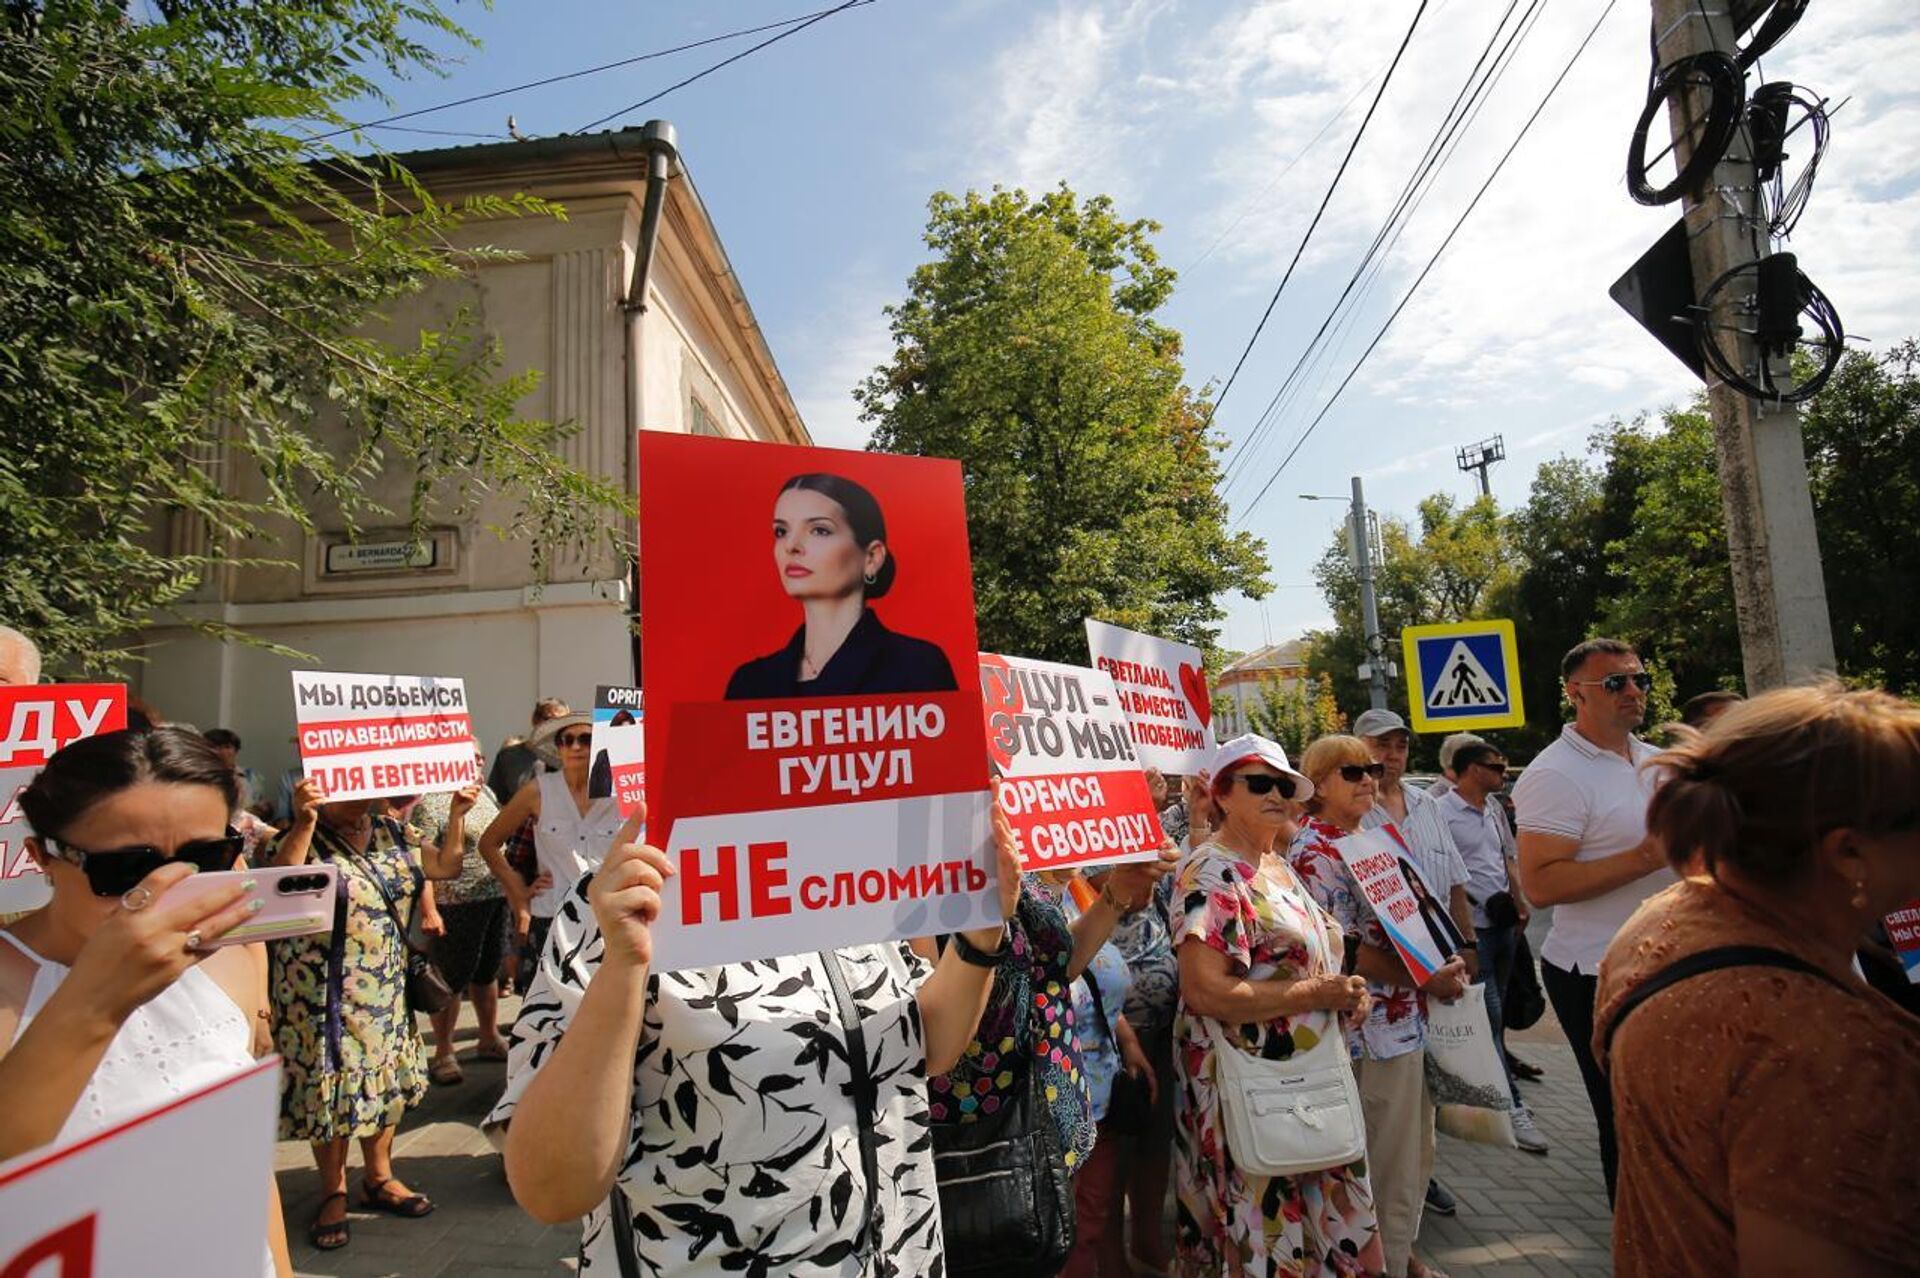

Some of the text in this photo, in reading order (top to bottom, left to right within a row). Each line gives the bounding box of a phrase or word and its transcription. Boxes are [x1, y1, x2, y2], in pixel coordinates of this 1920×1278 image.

[980, 664, 1088, 717] ГУЦУЛ
[1097, 656, 1175, 693] СВЕТЛАНА,
[299, 684, 463, 709] МЫ ДОБЬЕМСЯ
[304, 720, 468, 749] СПРАВЕДЛИВОСТИ
[746, 703, 946, 750] ЕВГЕНИЮ
[991, 712, 1063, 757] ЭТО
[1067, 720, 1135, 762] МЫ!
[311, 760, 476, 797] ДЛЯ ЕВГЕНИИ!
[618, 772, 645, 787] SVE
[778, 749, 913, 796] ГУЦУЛ
[622, 789, 645, 804] SU
[1000, 776, 1105, 816] ОРЕМСЯ
[1031, 813, 1155, 860] СВОБОДУ!
[679, 841, 792, 926] НЕ
[1885, 908, 1920, 925] СВЕТЛ
